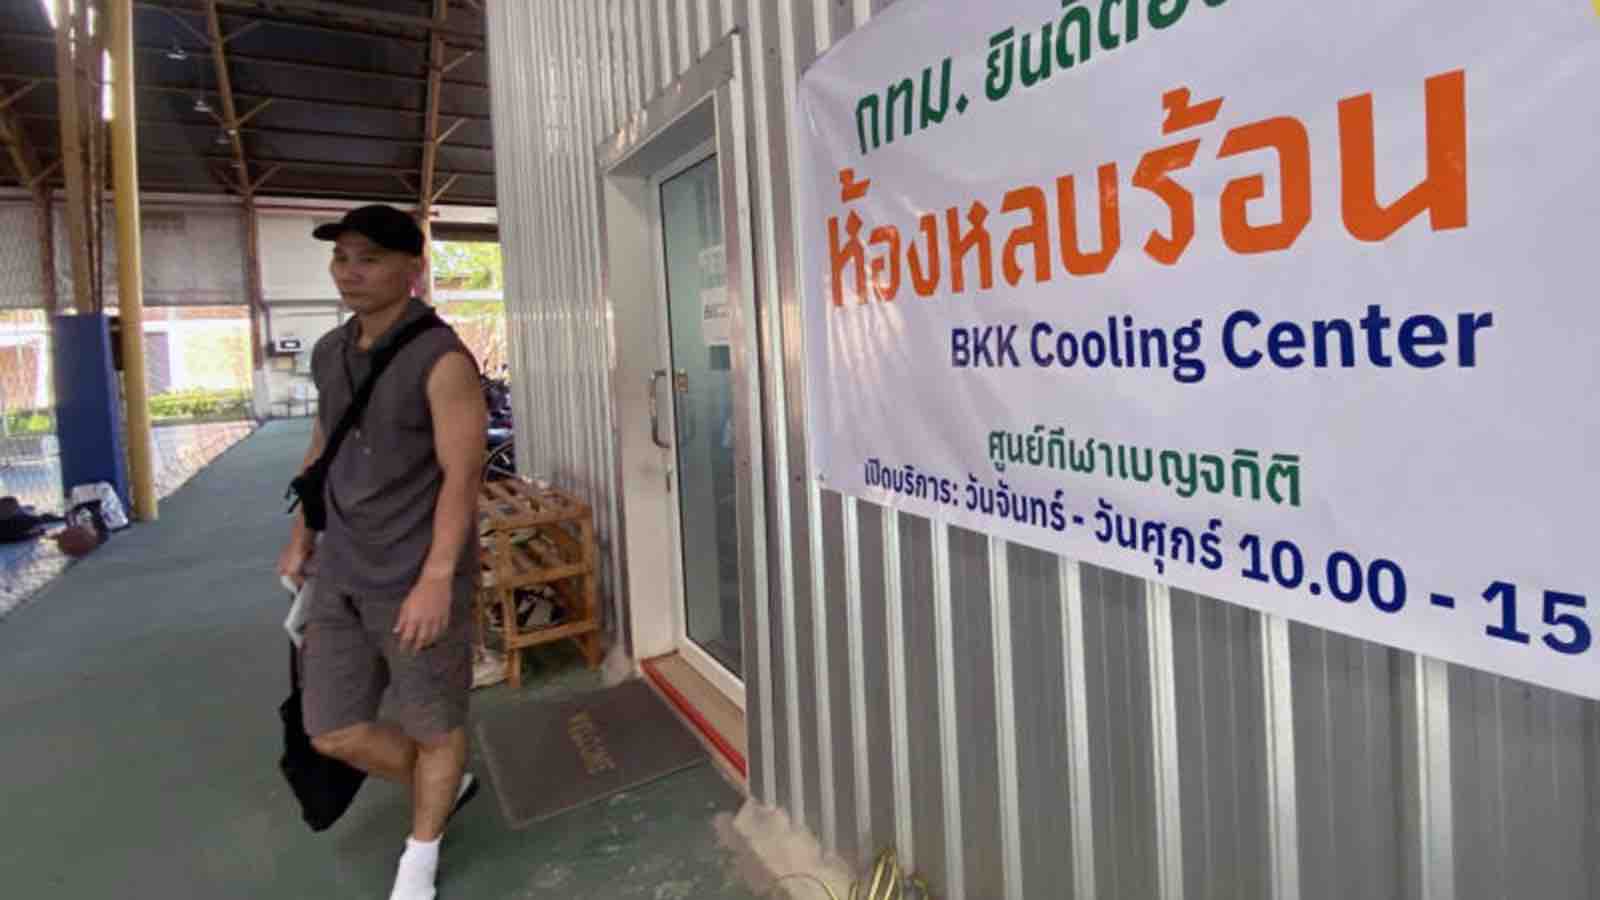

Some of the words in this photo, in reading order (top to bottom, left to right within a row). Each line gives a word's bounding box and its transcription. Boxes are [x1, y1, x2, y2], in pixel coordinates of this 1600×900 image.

[855, 58, 969, 155] กทม.
[825, 68, 1470, 306] ห้องหลบร้อน
[952, 325, 1020, 368] BKK
[1030, 315, 1208, 385] Cooling
[1222, 303, 1493, 369] Center
[1095, 498, 1225, 574] วันศุกร์
[1239, 533, 1408, 614] 10.00
[1480, 580, 1593, 656] 15
